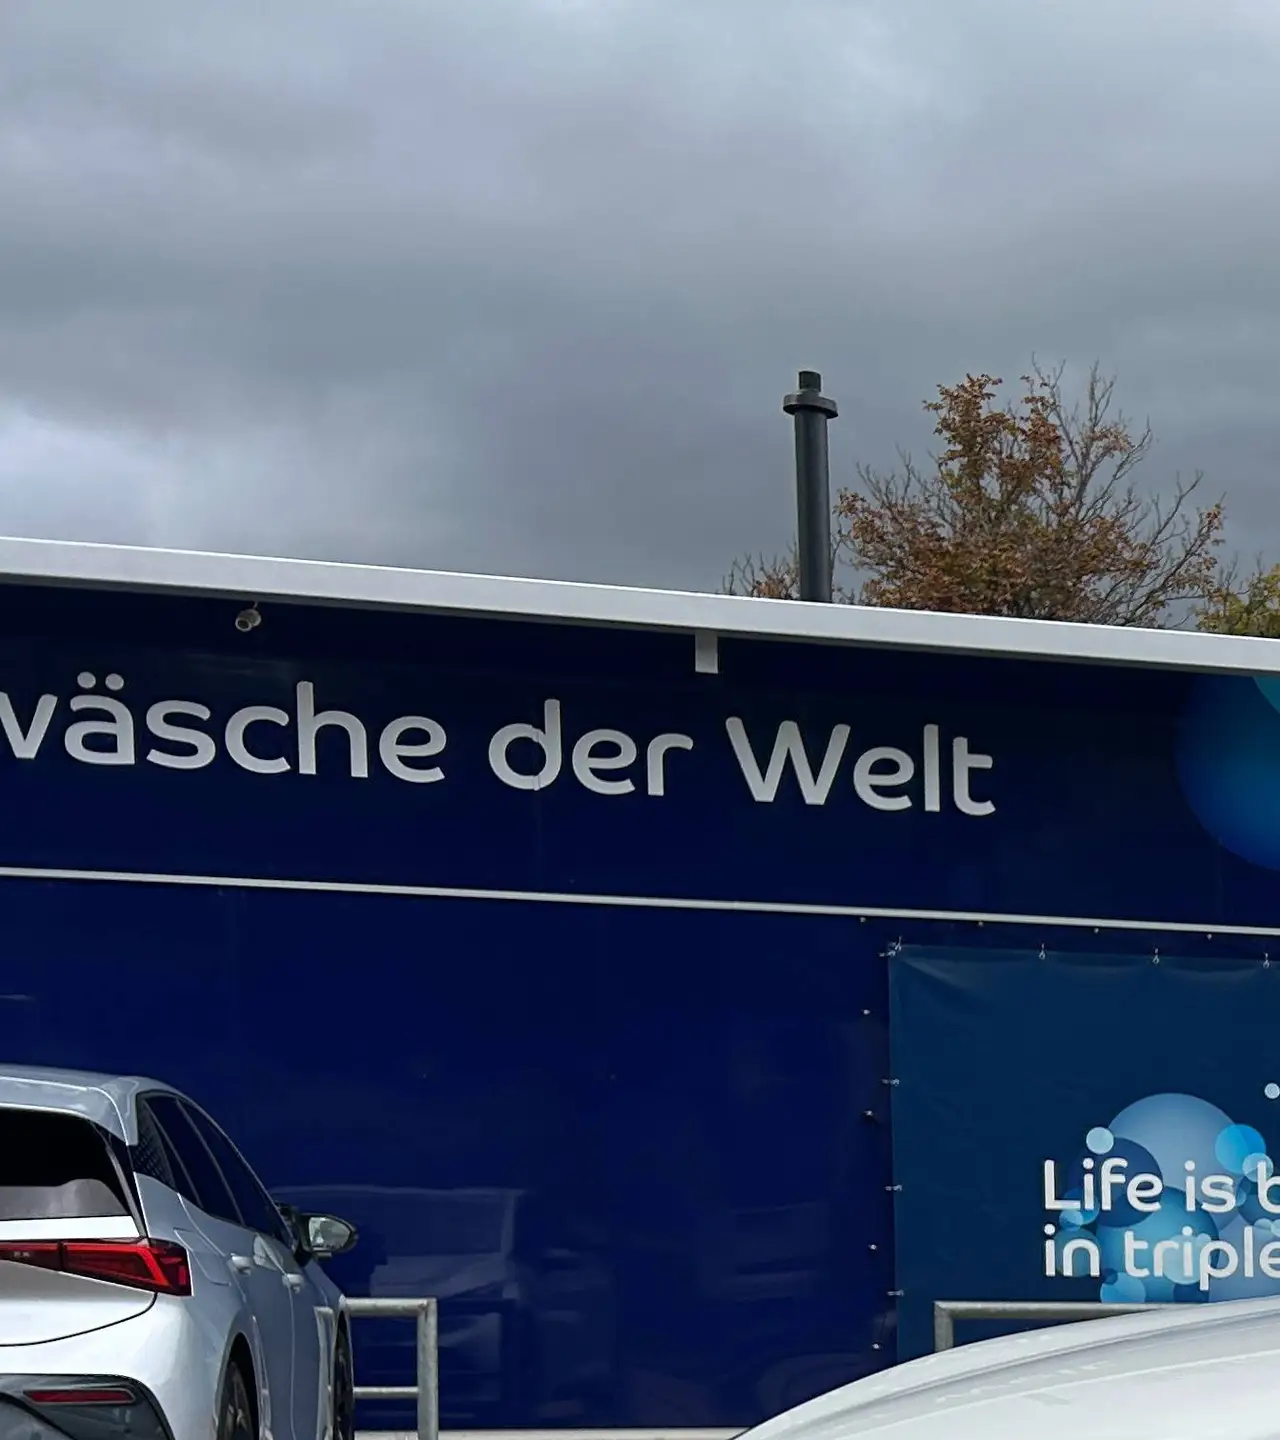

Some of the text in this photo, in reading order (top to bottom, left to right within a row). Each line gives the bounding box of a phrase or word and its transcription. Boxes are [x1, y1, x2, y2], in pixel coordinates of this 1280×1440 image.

[488, 698, 694, 796] der
[725, 715, 997, 816] Welt
[1044, 1157, 1163, 1212] Life
[1185, 1160, 1237, 1212] is
[1044, 1224, 1099, 1278] in
